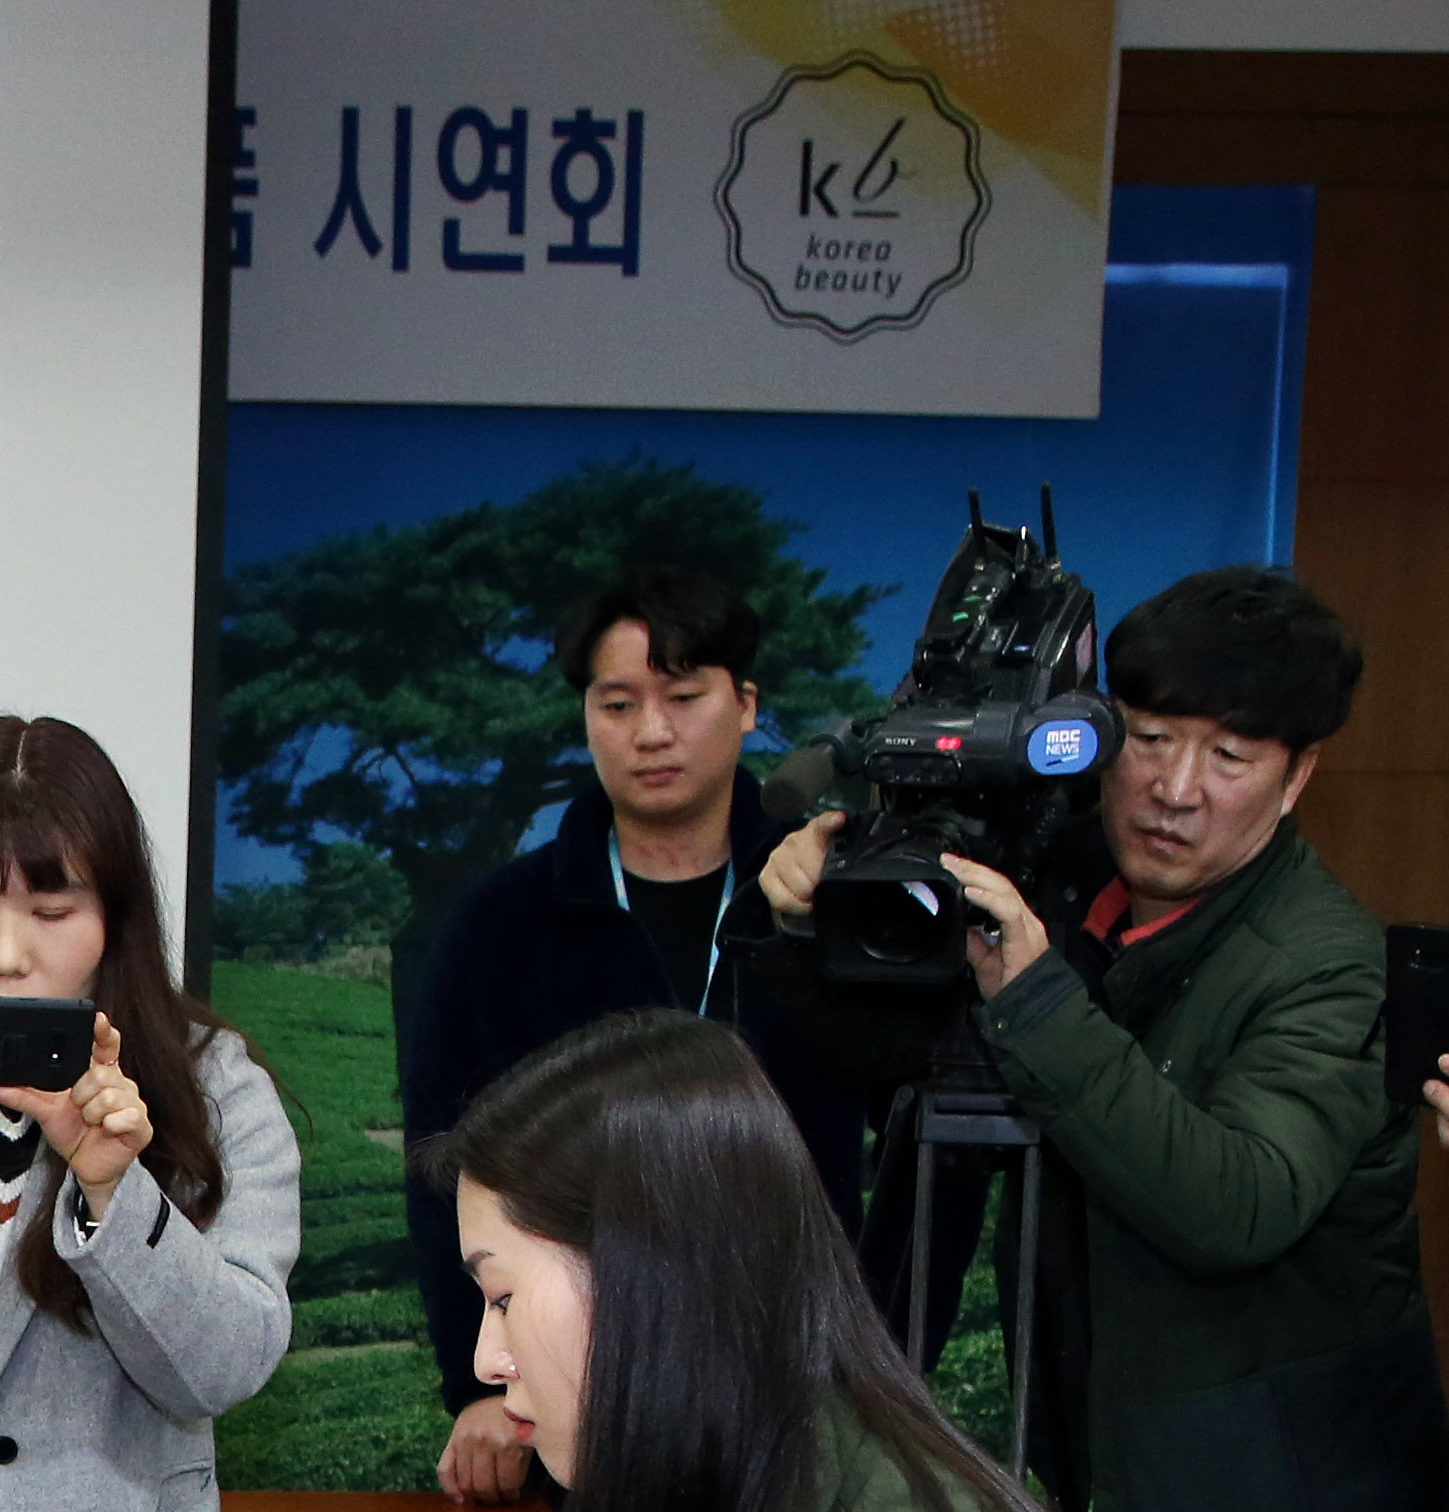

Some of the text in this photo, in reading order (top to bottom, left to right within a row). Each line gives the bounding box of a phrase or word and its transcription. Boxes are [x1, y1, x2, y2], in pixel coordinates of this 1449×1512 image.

[313, 104, 645, 278] 시연회
[806, 232, 892, 262] korea
[794, 263, 902, 299] beauty
[1045, 743, 1080, 756] NEWS
